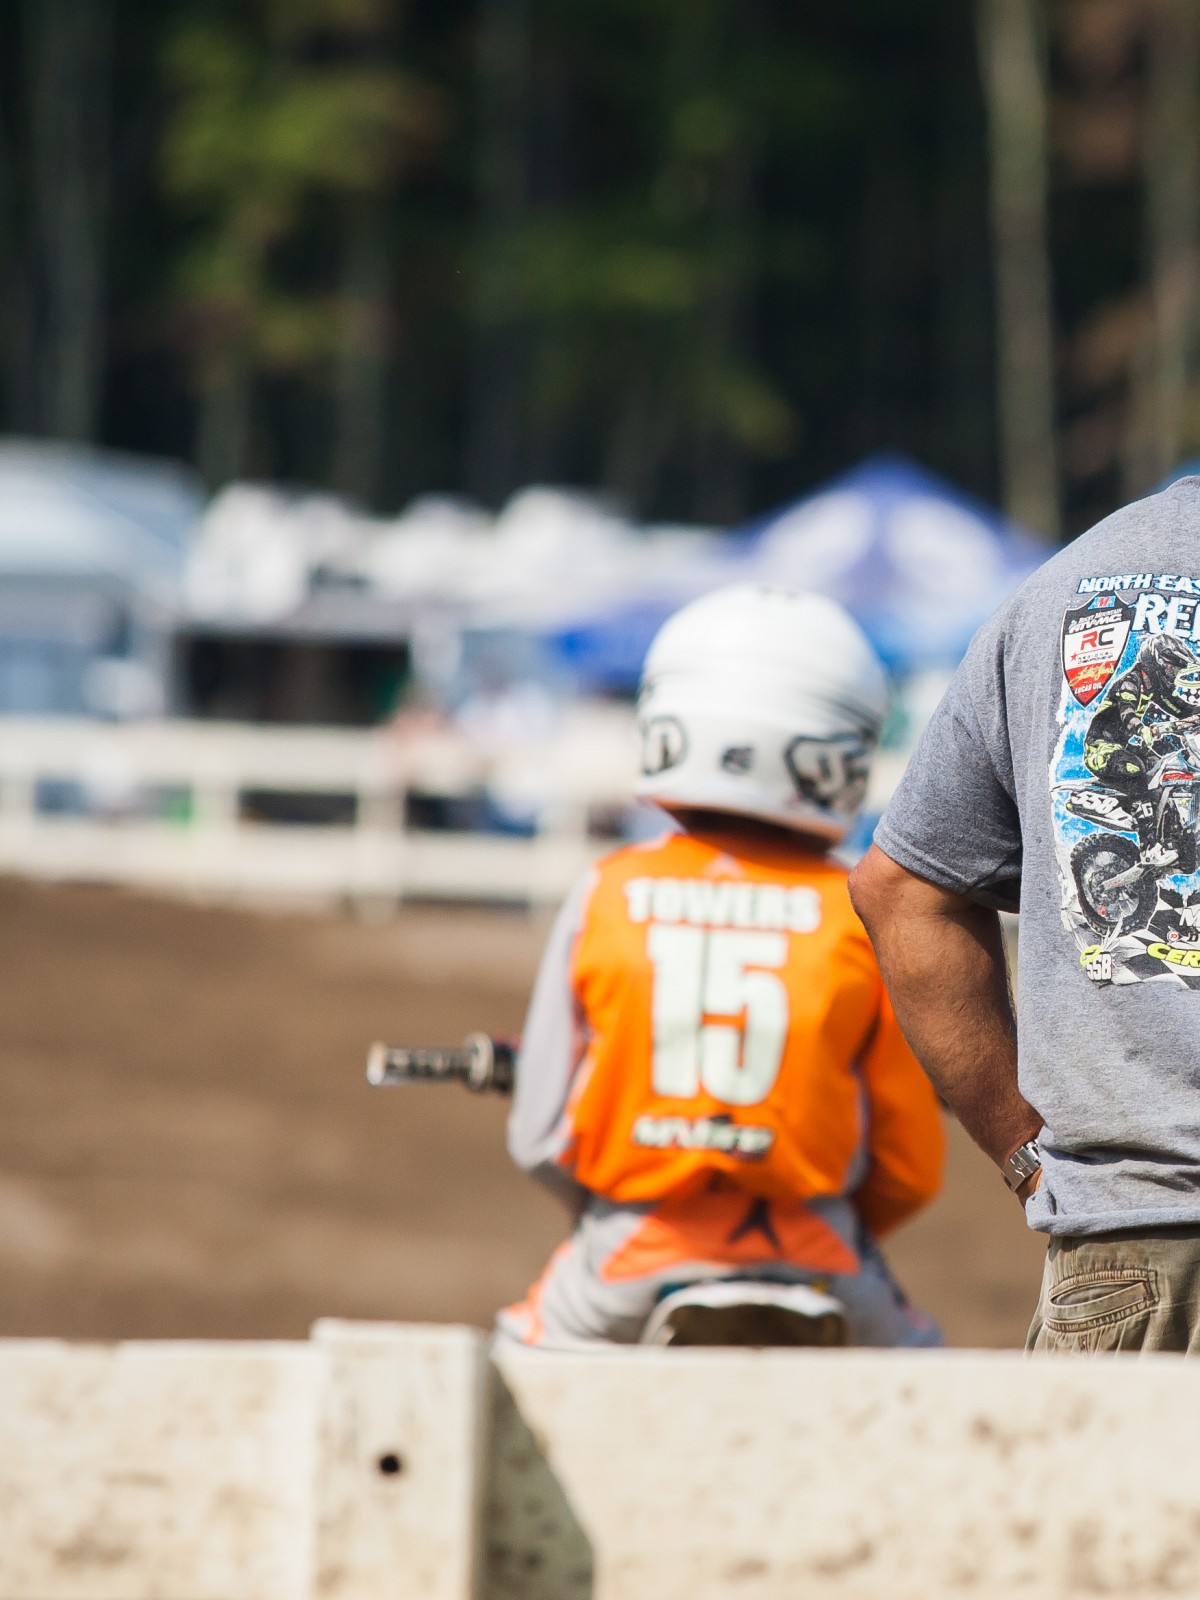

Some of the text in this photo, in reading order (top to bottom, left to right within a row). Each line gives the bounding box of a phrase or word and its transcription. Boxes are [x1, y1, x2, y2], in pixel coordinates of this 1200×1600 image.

[1078, 574, 1152, 595] NORTH
[1081, 628, 1114, 650] RC
[623, 876, 823, 933] TOWERS
[646, 923, 790, 1106] 15
